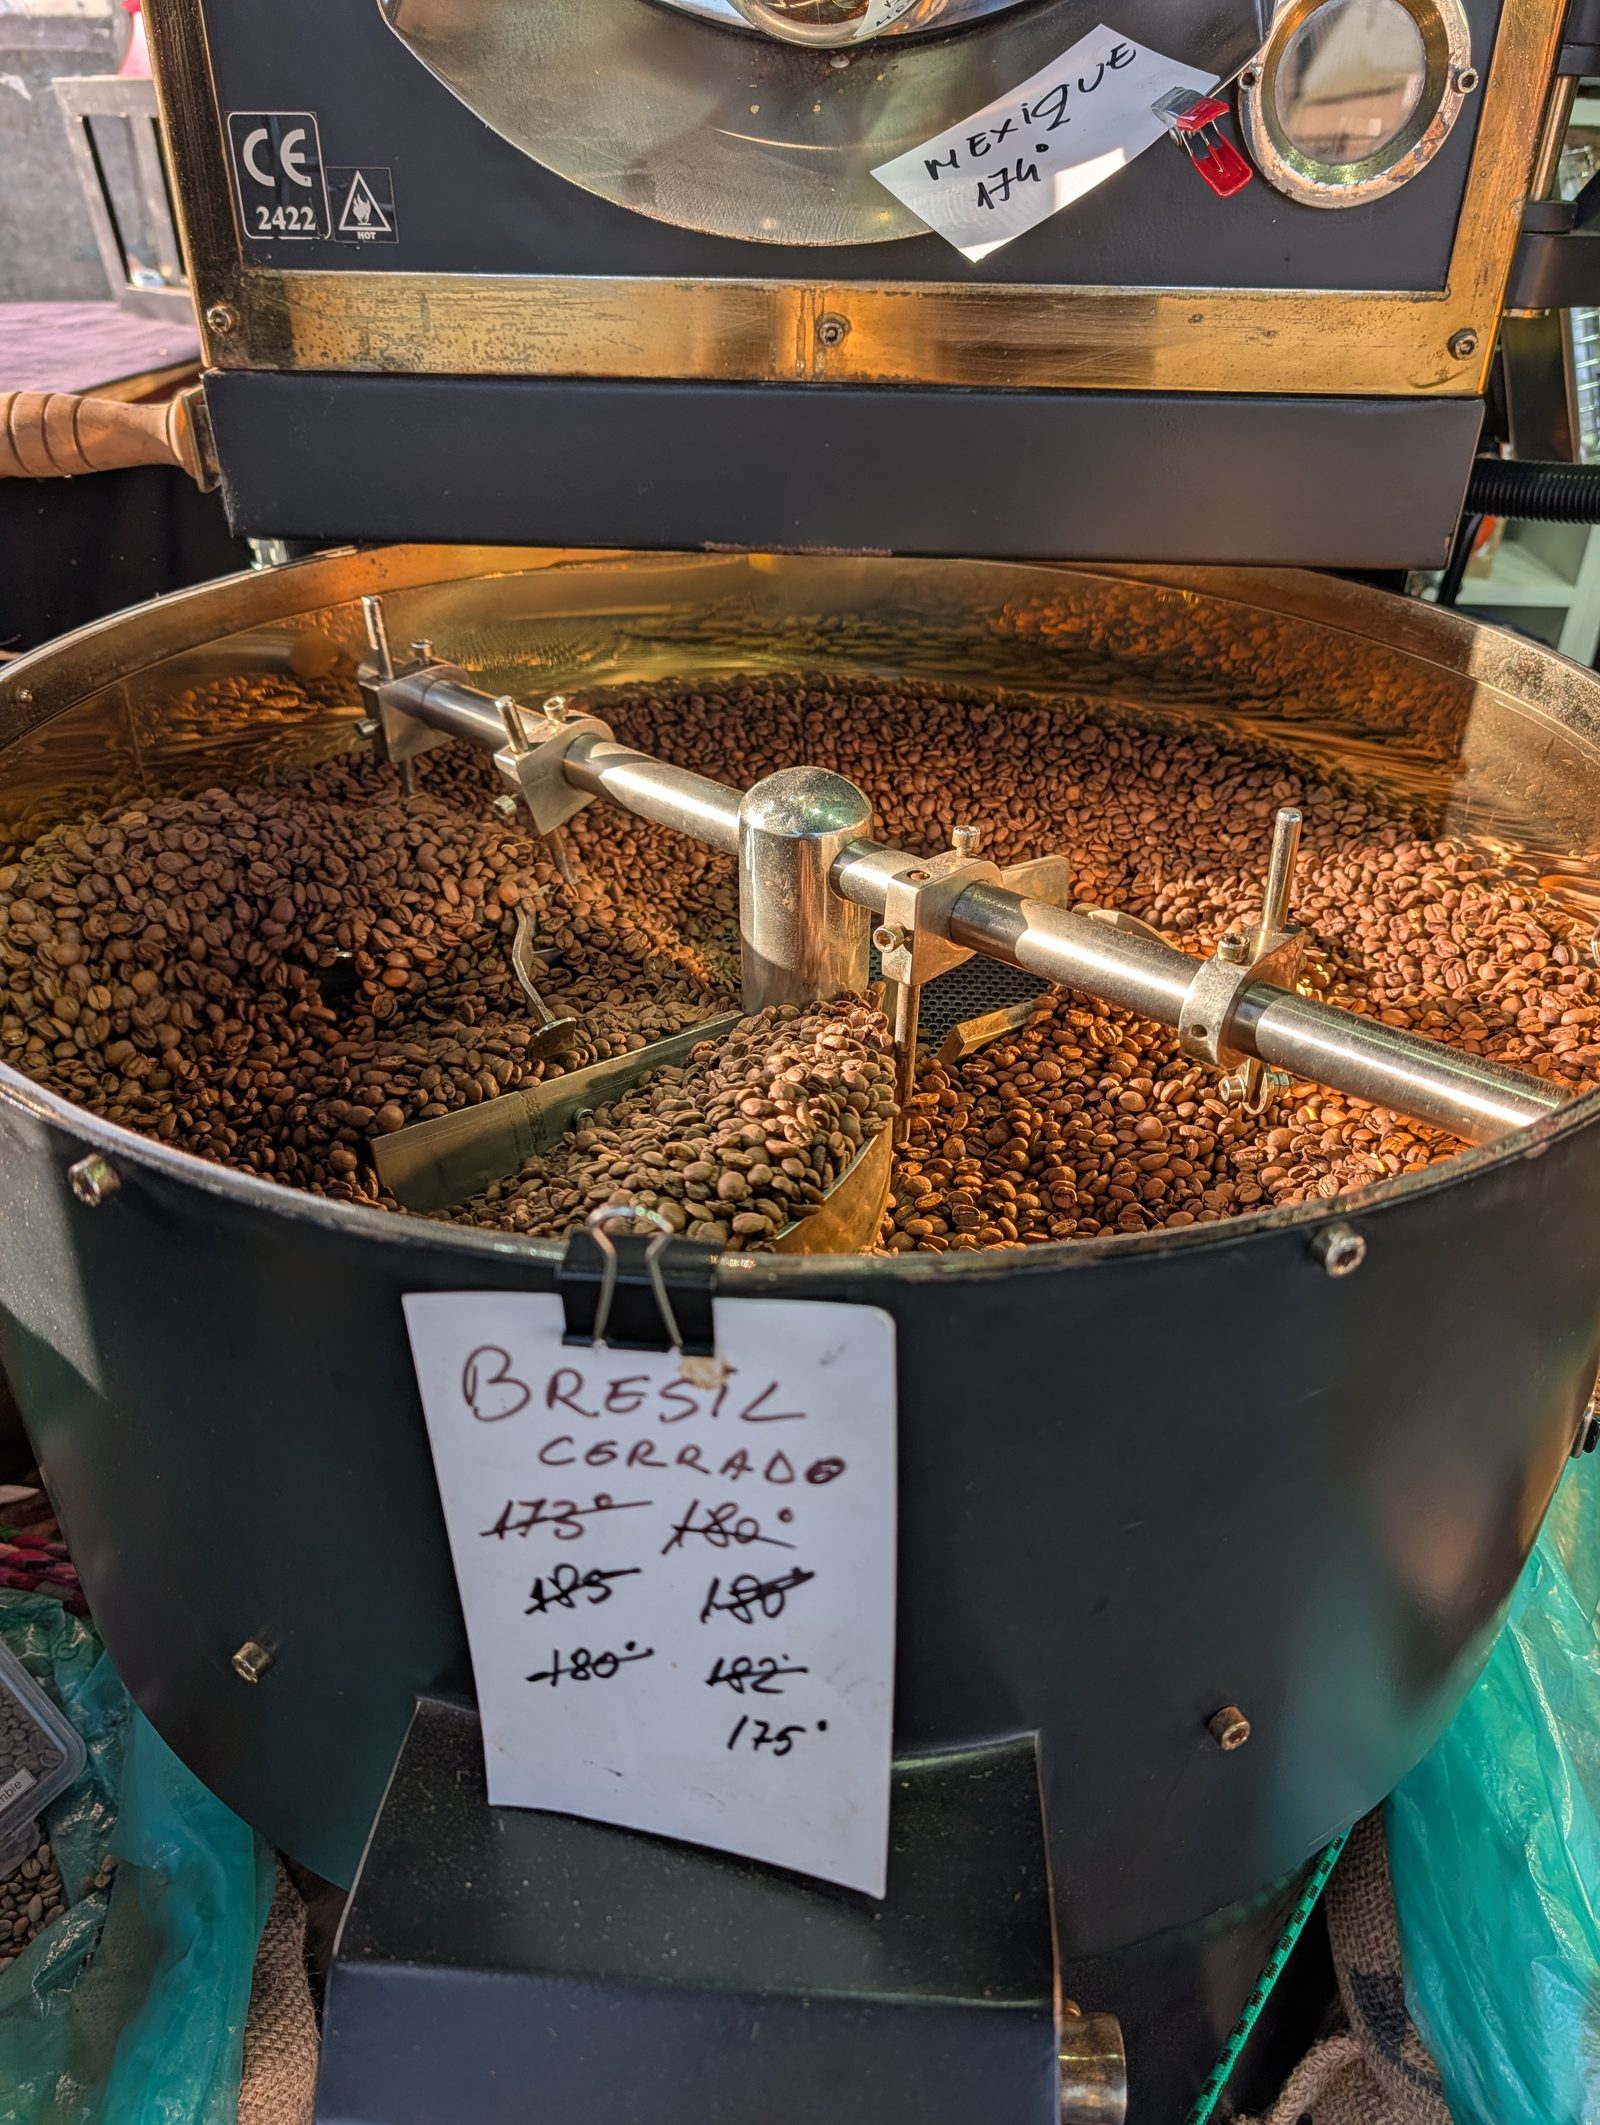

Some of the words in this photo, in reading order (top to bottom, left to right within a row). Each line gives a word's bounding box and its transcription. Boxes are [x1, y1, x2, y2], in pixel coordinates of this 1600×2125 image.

[243, 128, 312, 187] CE
[256, 205, 316, 230] 2422
[357, 231, 377, 240] HOT
[538, 1436, 847, 1485] CERRADO
[727, 1715, 828, 1756] 175°
